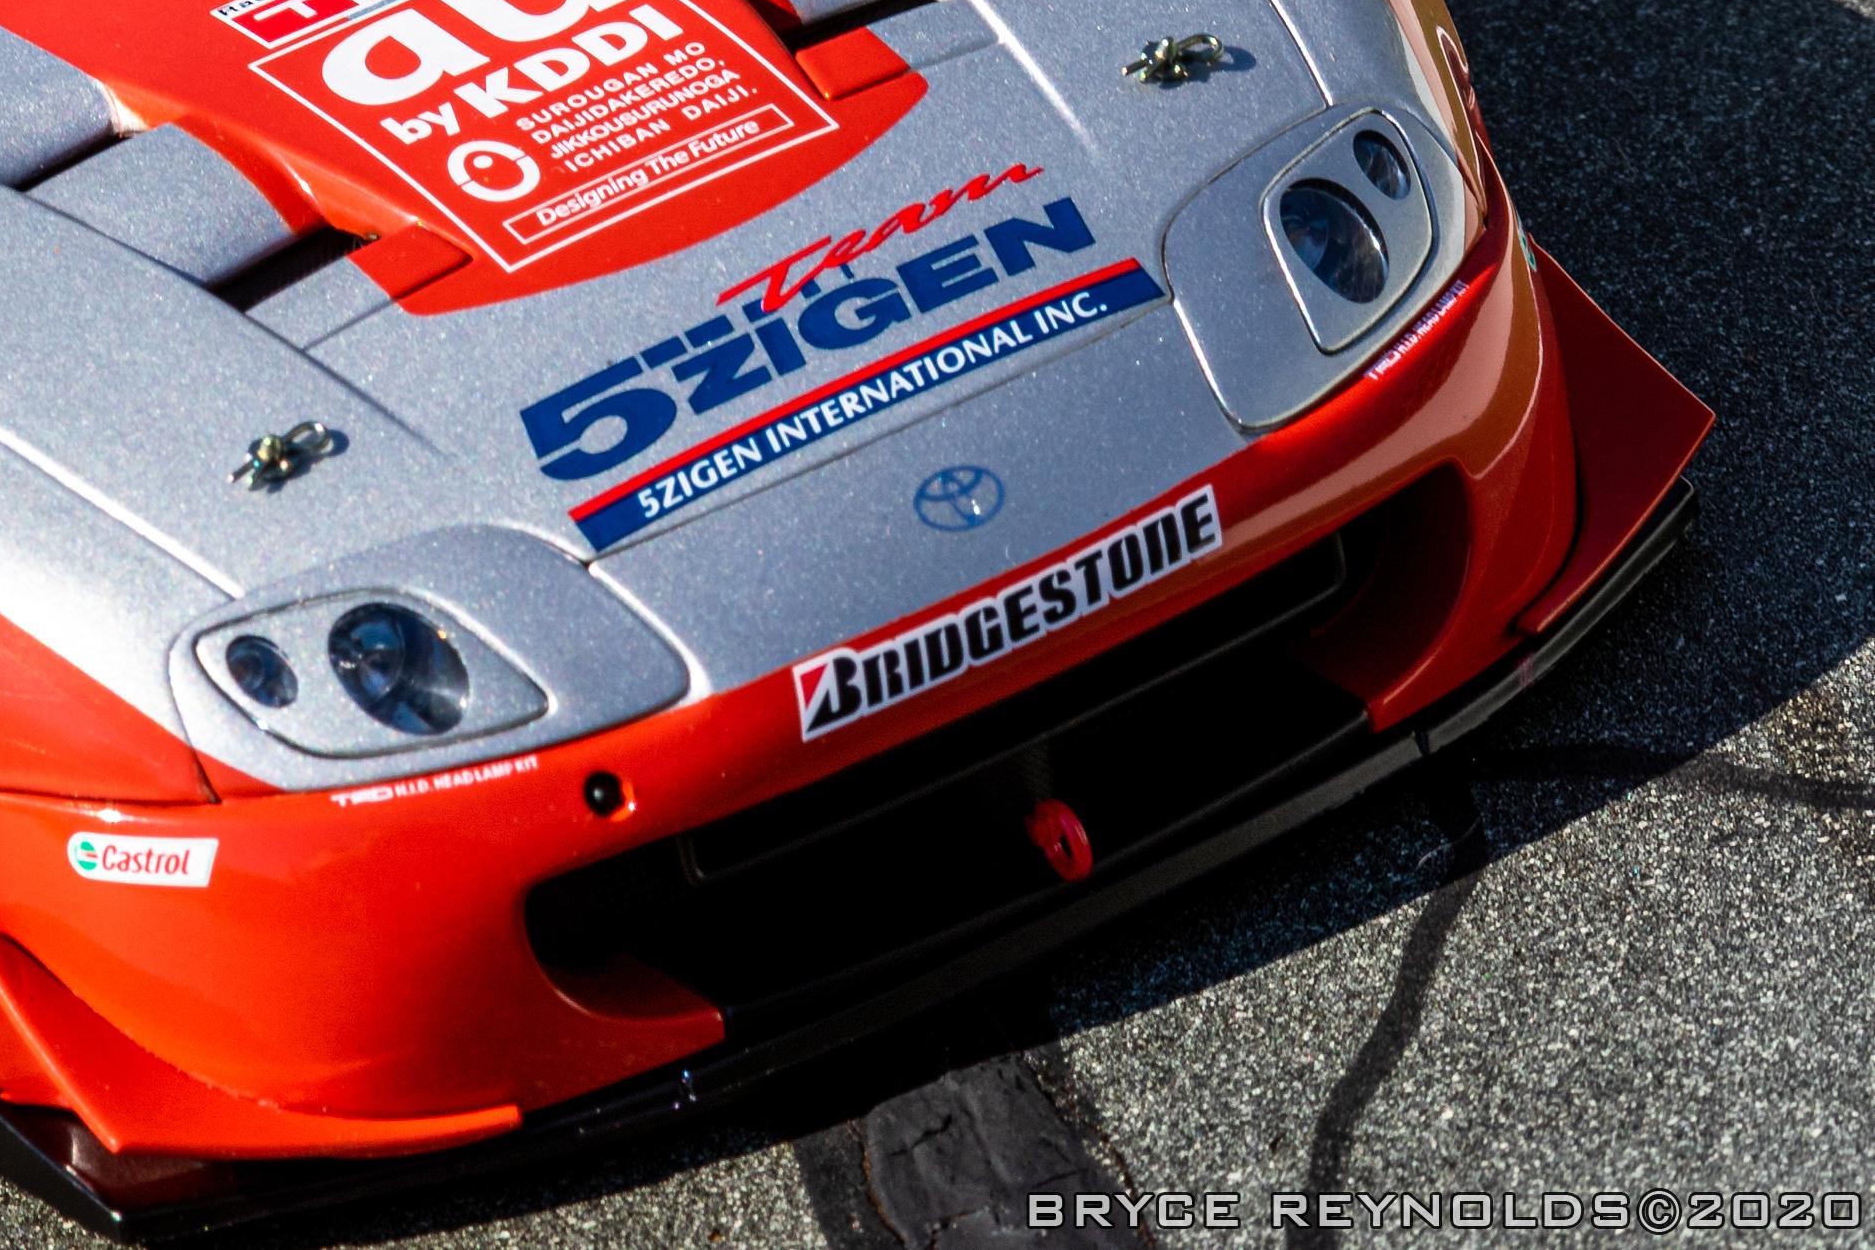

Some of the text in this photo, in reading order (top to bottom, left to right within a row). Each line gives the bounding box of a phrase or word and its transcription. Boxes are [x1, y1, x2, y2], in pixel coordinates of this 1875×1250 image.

[380, 4, 685, 146] by KDDI
[515, 41, 706, 131] SUROUGAN MO
[531, 56, 726, 146] DAIJIDAKEREDO,
[550, 70, 741, 160] JIKKOUSURUNOGA
[536, 119, 761, 228] Designing The Future
[564, 86, 758, 172] ICHIBAN DAIJI.
[716, 162, 1044, 314] Team
[637, 290, 1109, 519] 5ZIGEN INTERNATIONAL INC.
[805, 492, 1216, 733] BRIDGESTONE
[101, 844, 190, 876] Castrol
